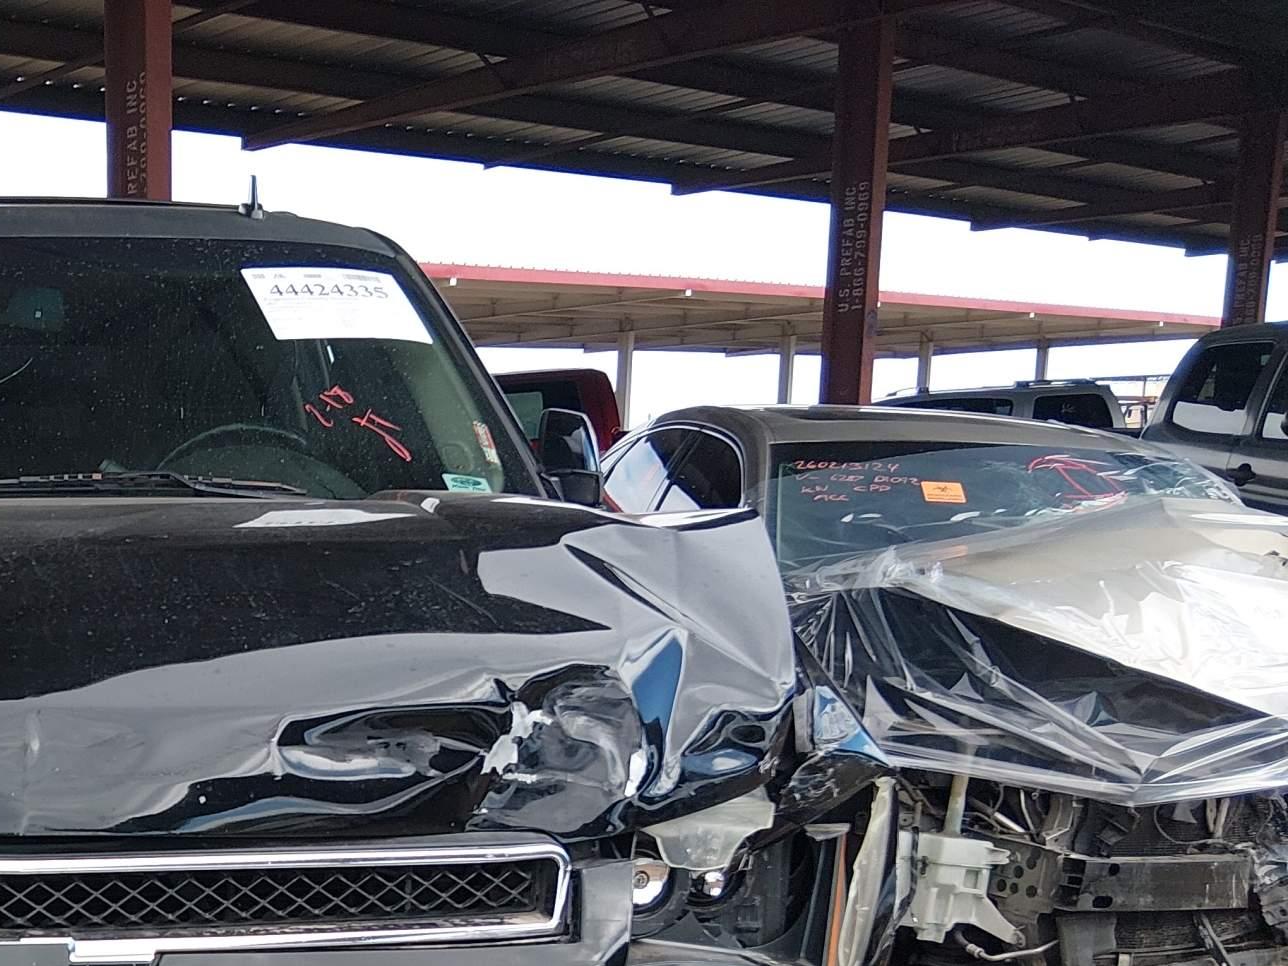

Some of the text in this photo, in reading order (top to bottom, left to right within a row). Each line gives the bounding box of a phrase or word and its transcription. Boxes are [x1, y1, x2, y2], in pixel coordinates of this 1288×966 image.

[125, 79, 138, 115] INC
[843, 186, 858, 212] INC
[839, 217, 856, 277] PREFAB
[850, 180, 870, 312] 1-866-799-0969
[269, 283, 390, 300] 44424335
